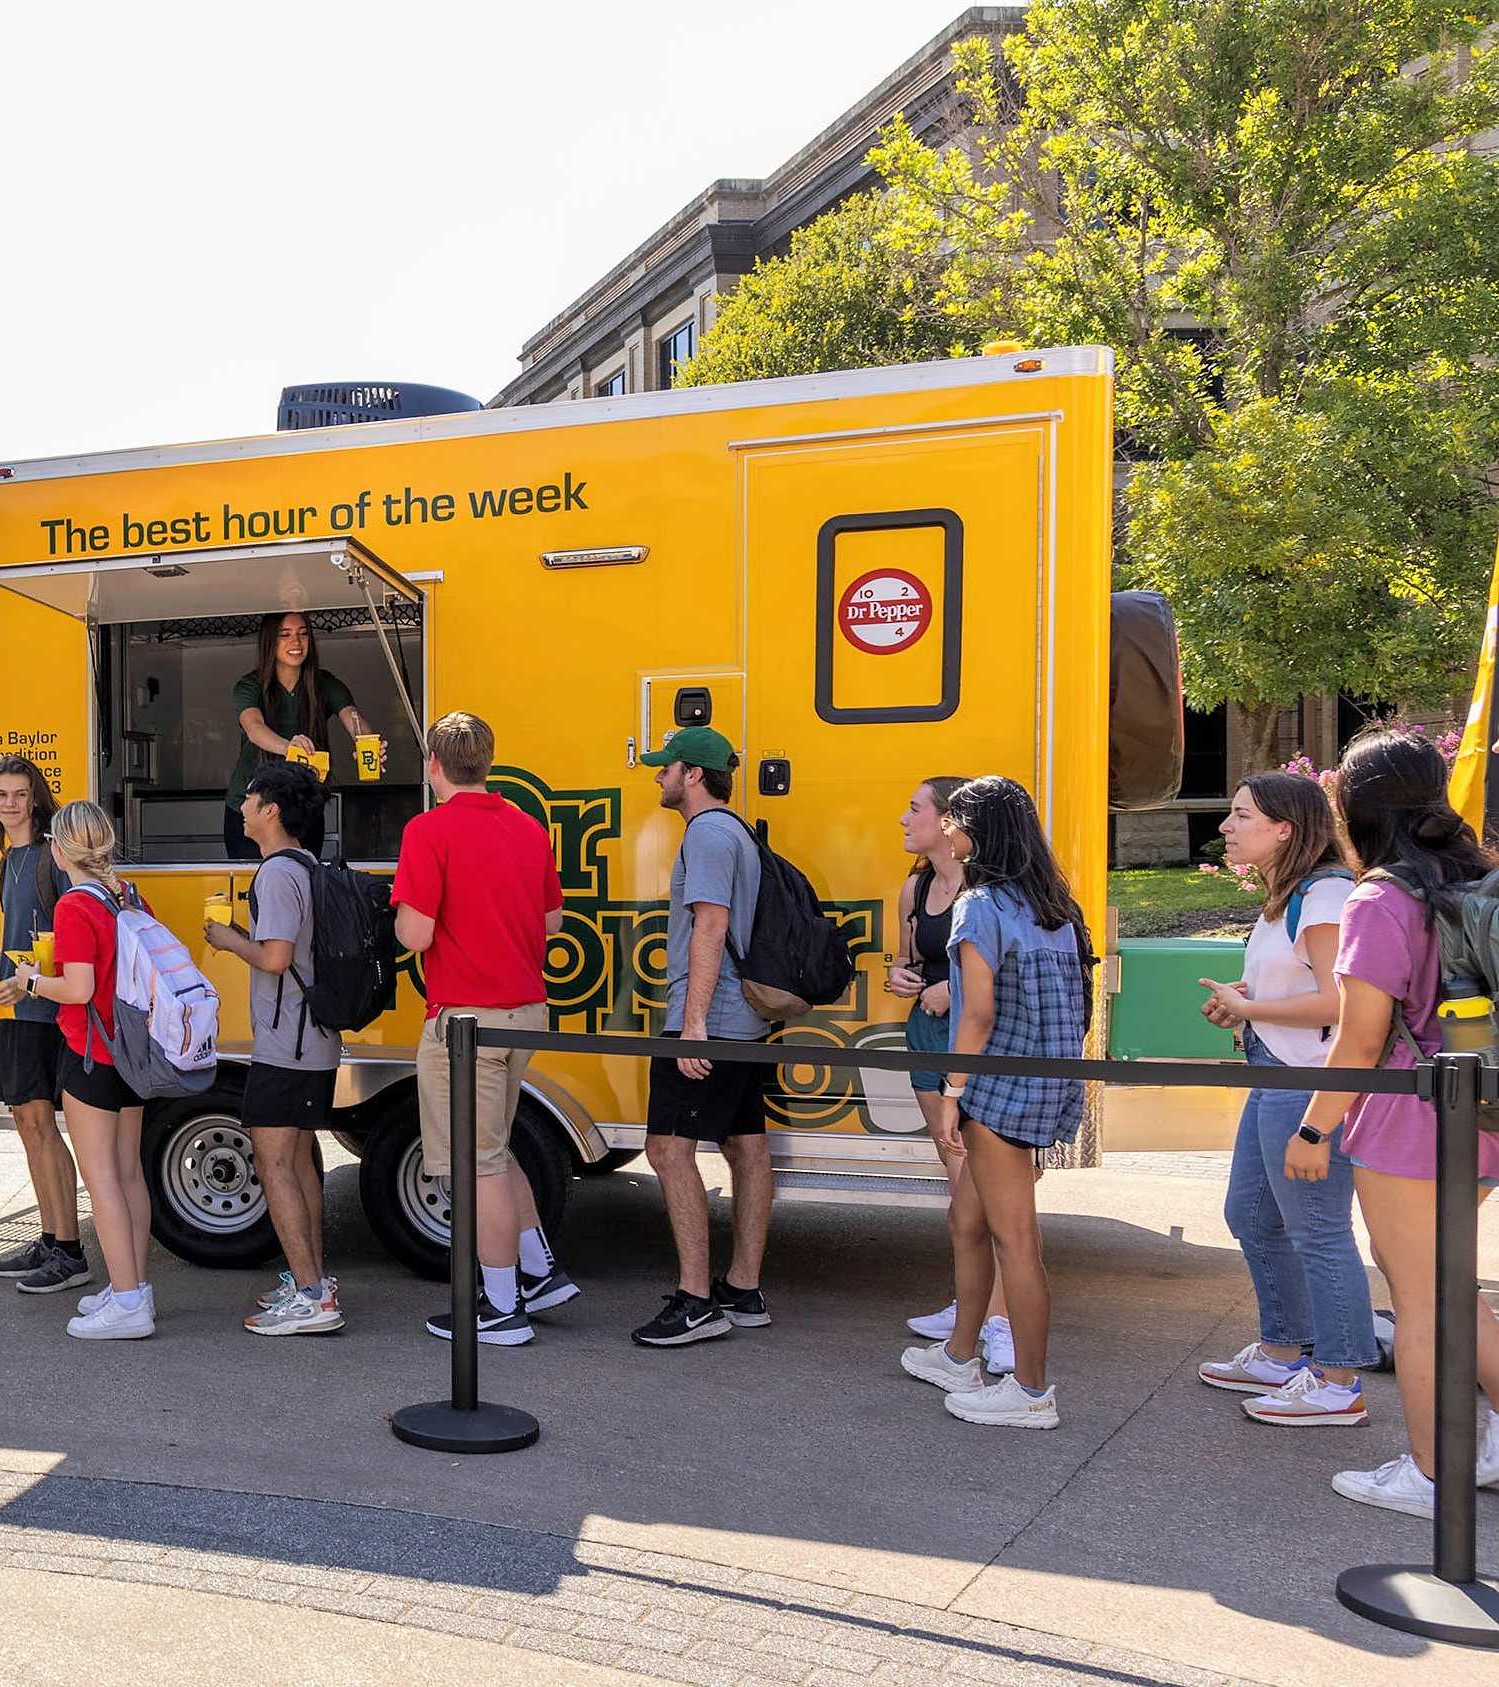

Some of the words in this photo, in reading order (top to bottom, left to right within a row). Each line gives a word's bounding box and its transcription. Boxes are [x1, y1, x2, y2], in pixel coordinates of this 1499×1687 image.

[41, 519, 109, 554] The
[123, 512, 211, 548] best
[223, 504, 317, 540] hour
[330, 491, 371, 530] of
[383, 487, 455, 526] the
[469, 472, 589, 518] week
[901, 587, 909, 597] 2
[847, 606, 867, 619] Dr
[869, 601, 923, 622] Pepper
[895, 627, 904, 637] 4
[8, 730, 57, 748] Baylor
[362, 750, 377, 771] BU
